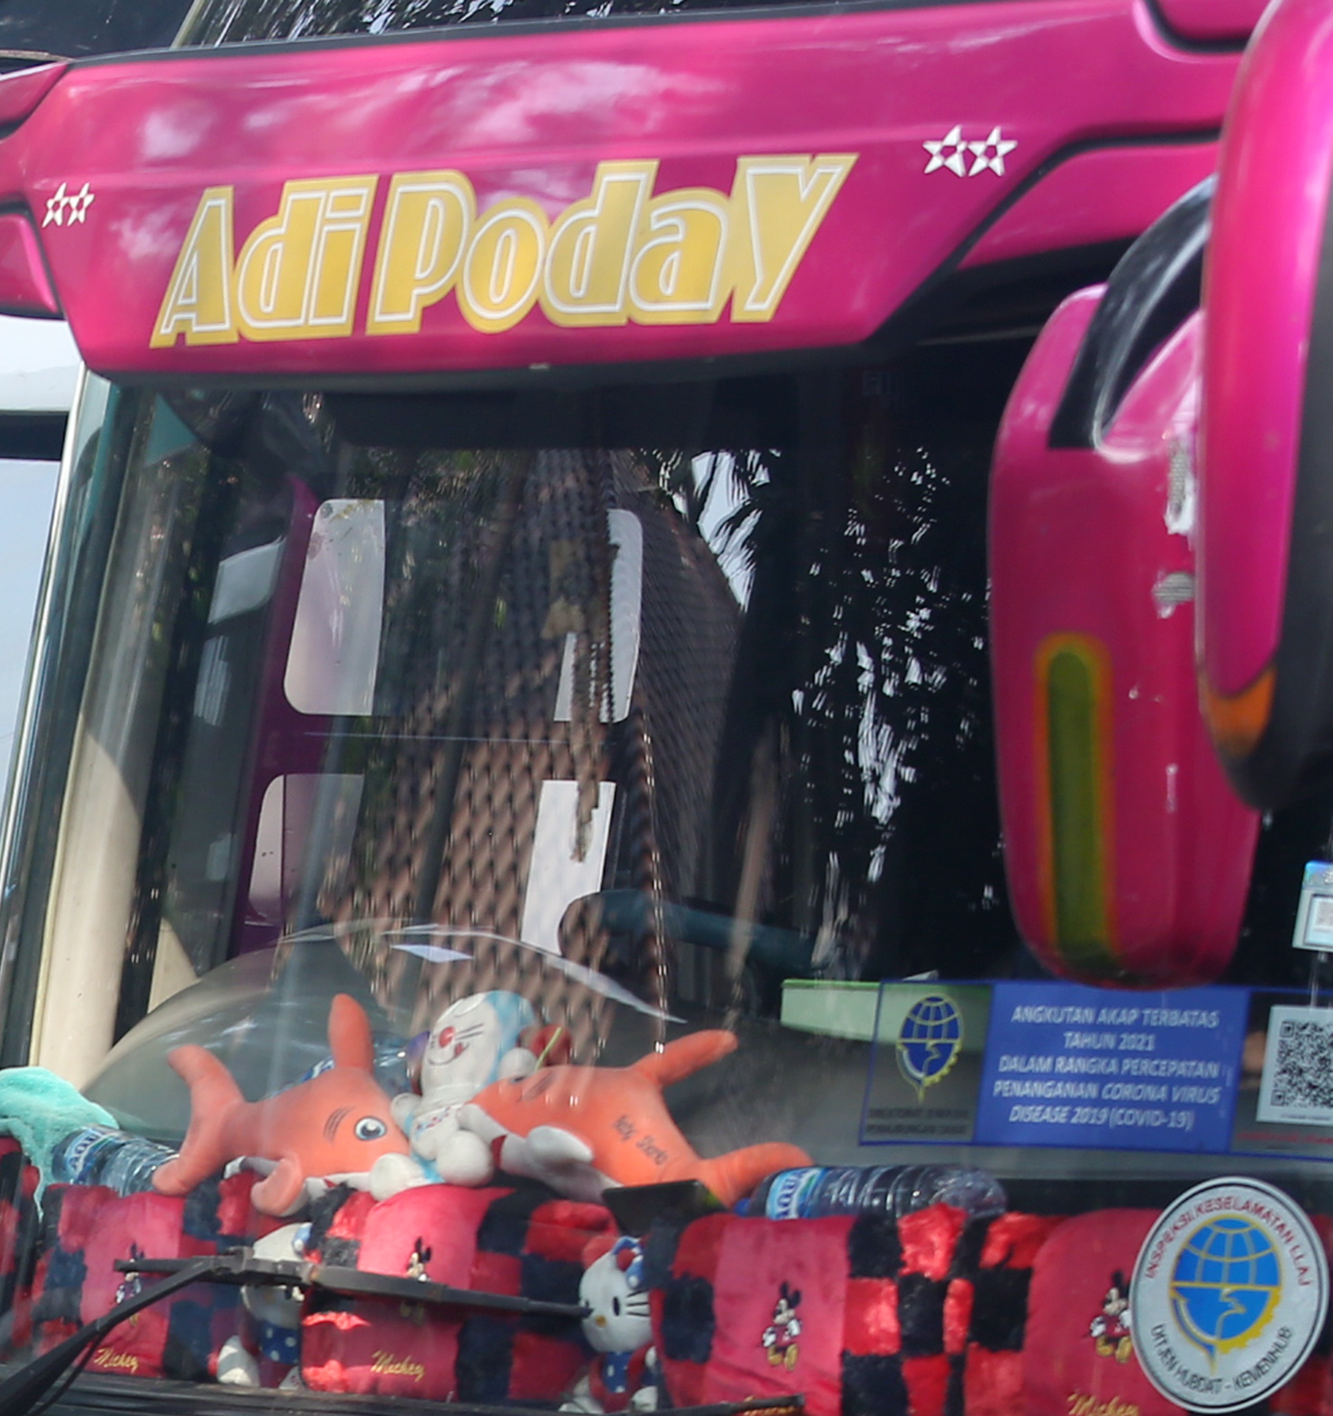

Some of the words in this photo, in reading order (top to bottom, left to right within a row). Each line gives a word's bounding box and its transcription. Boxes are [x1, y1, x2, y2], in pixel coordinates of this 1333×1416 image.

[149, 175, 379, 348] Adi
[1011, 1005, 1094, 1025] ANGKUTAN
[1096, 1006, 1139, 1026] AKAP
[1142, 1008, 1219, 1028] TERBATAS
[1064, 1031, 1115, 1050] TAHUN
[1118, 1033, 1155, 1051] 2021
[999, 1055, 1053, 1073] DALAM
[1055, 1056, 1118, 1075] RANGKA
[1121, 1058, 1219, 1078] PERCEPATAN
[993, 1080, 1098, 1099] PENANGANAN
[1101, 1083, 1168, 1101] CORONA
[1170, 1085, 1221, 1104] VIRUS
[1009, 1105, 1068, 1124] DISEASE
[1071, 1106, 1108, 1125] 2019
[1108, 1107, 1194, 1130] (COVID-19)
[1196, 1196, 1295, 1244] KESELAMATAN
[370, 1350, 425, 1382] Mickey
